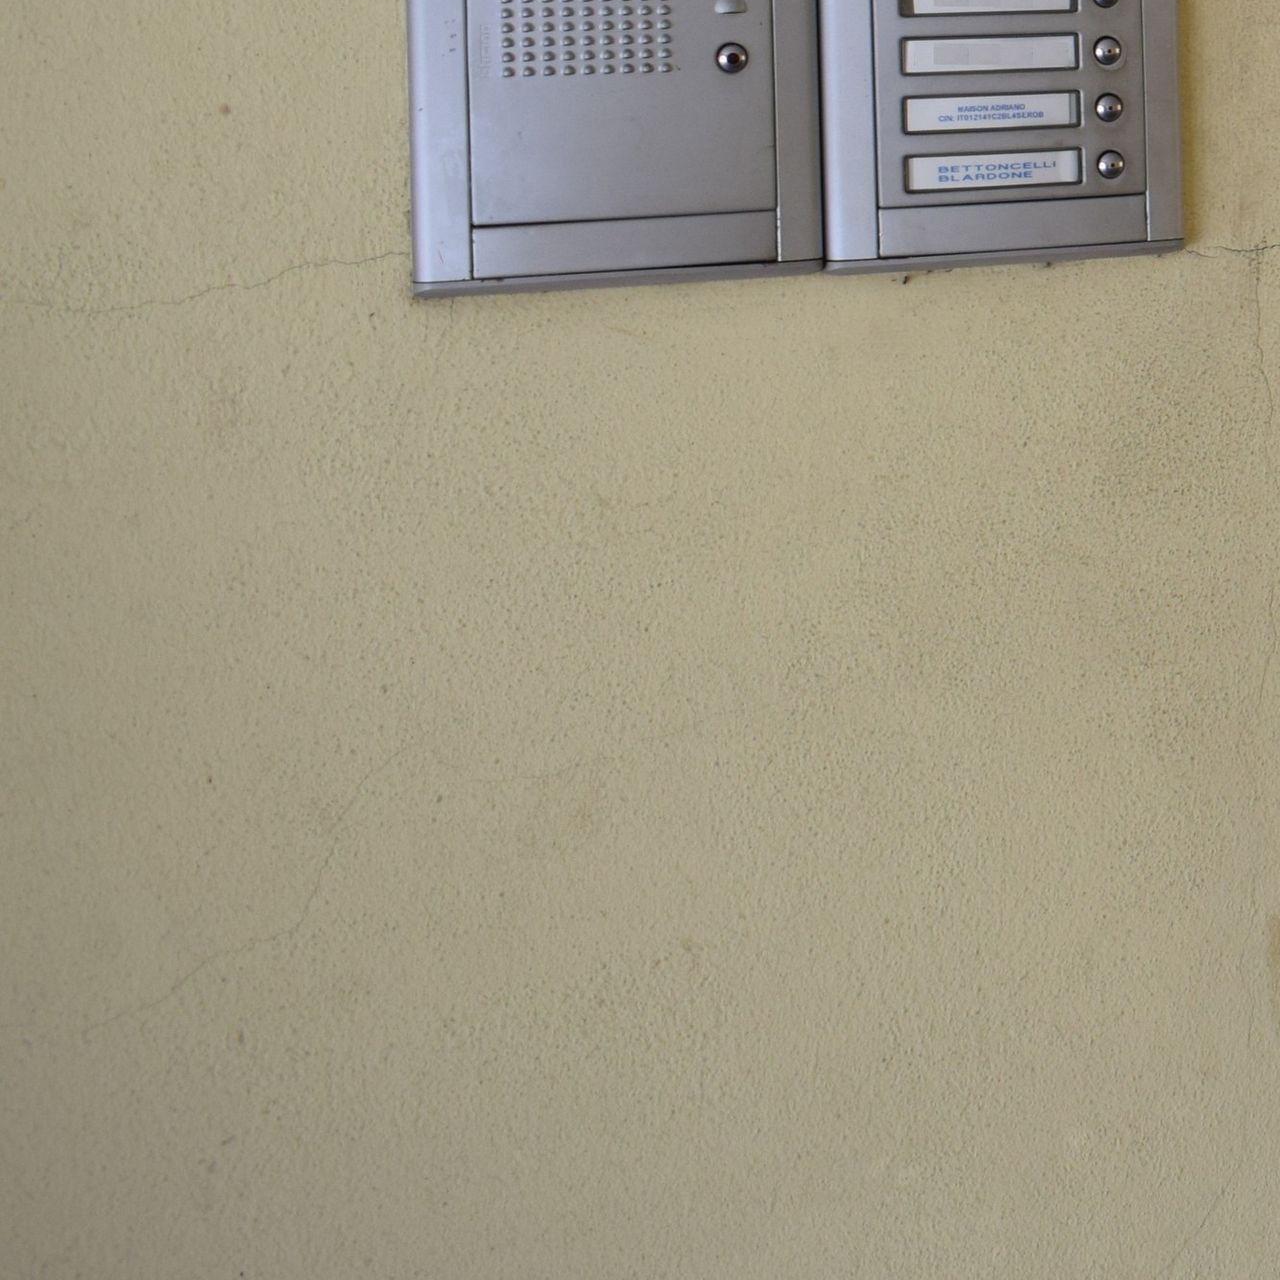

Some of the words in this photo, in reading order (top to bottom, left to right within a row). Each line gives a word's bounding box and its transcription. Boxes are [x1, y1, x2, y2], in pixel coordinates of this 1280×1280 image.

[957, 104, 990, 113] MAISON
[991, 103, 1026, 112] ADRIANO
[937, 161, 1057, 173] BETTONCELLI
[938, 172, 1033, 183] BLARDONE
